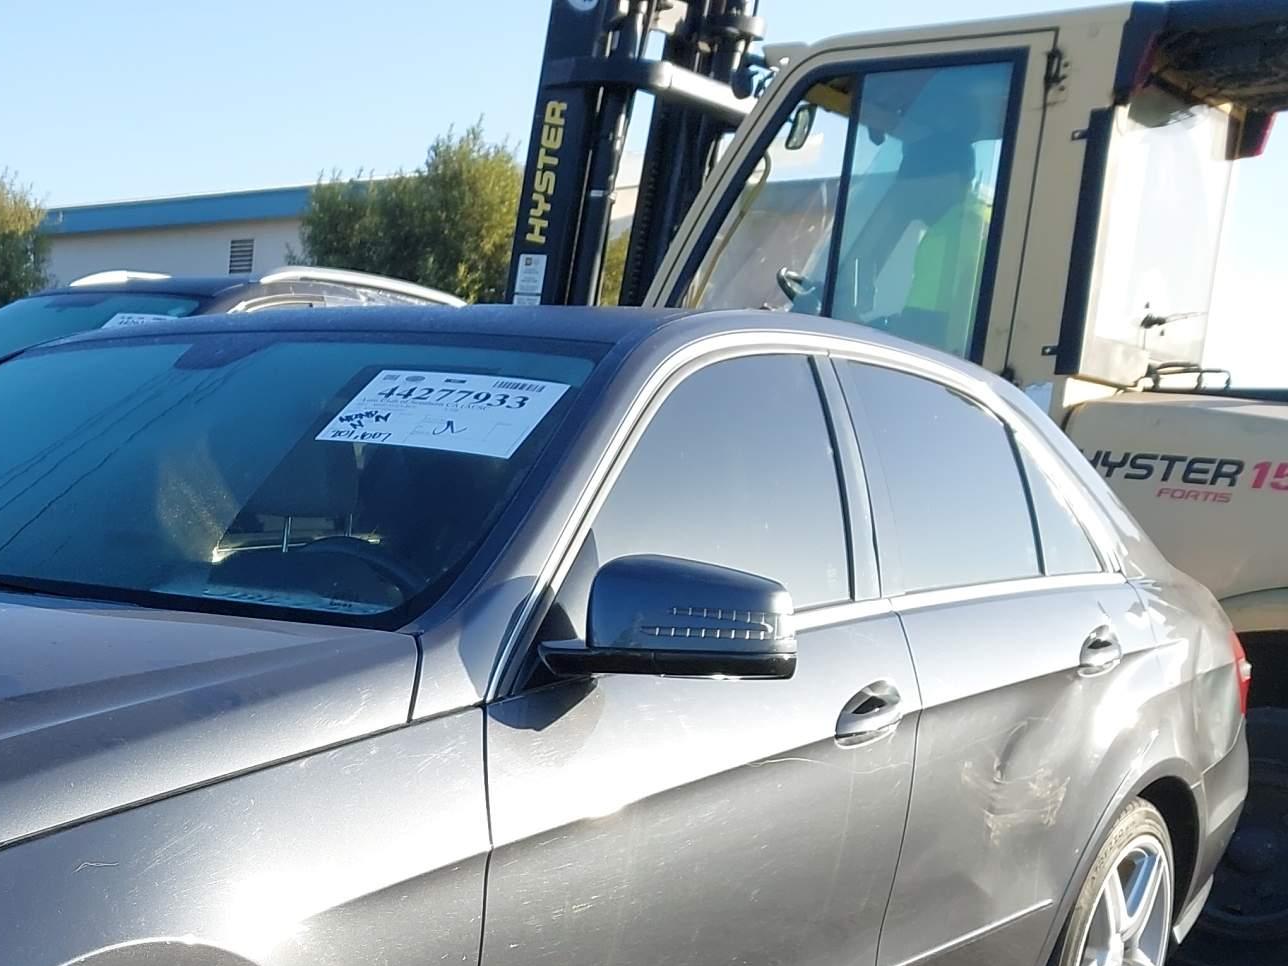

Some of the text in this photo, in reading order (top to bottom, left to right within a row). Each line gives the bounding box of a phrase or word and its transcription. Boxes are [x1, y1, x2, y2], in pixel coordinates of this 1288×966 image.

[525, 100, 568, 245] HYSTER
[379, 384, 530, 410] 44277933
[1155, 488, 1233, 504] FORTIS
